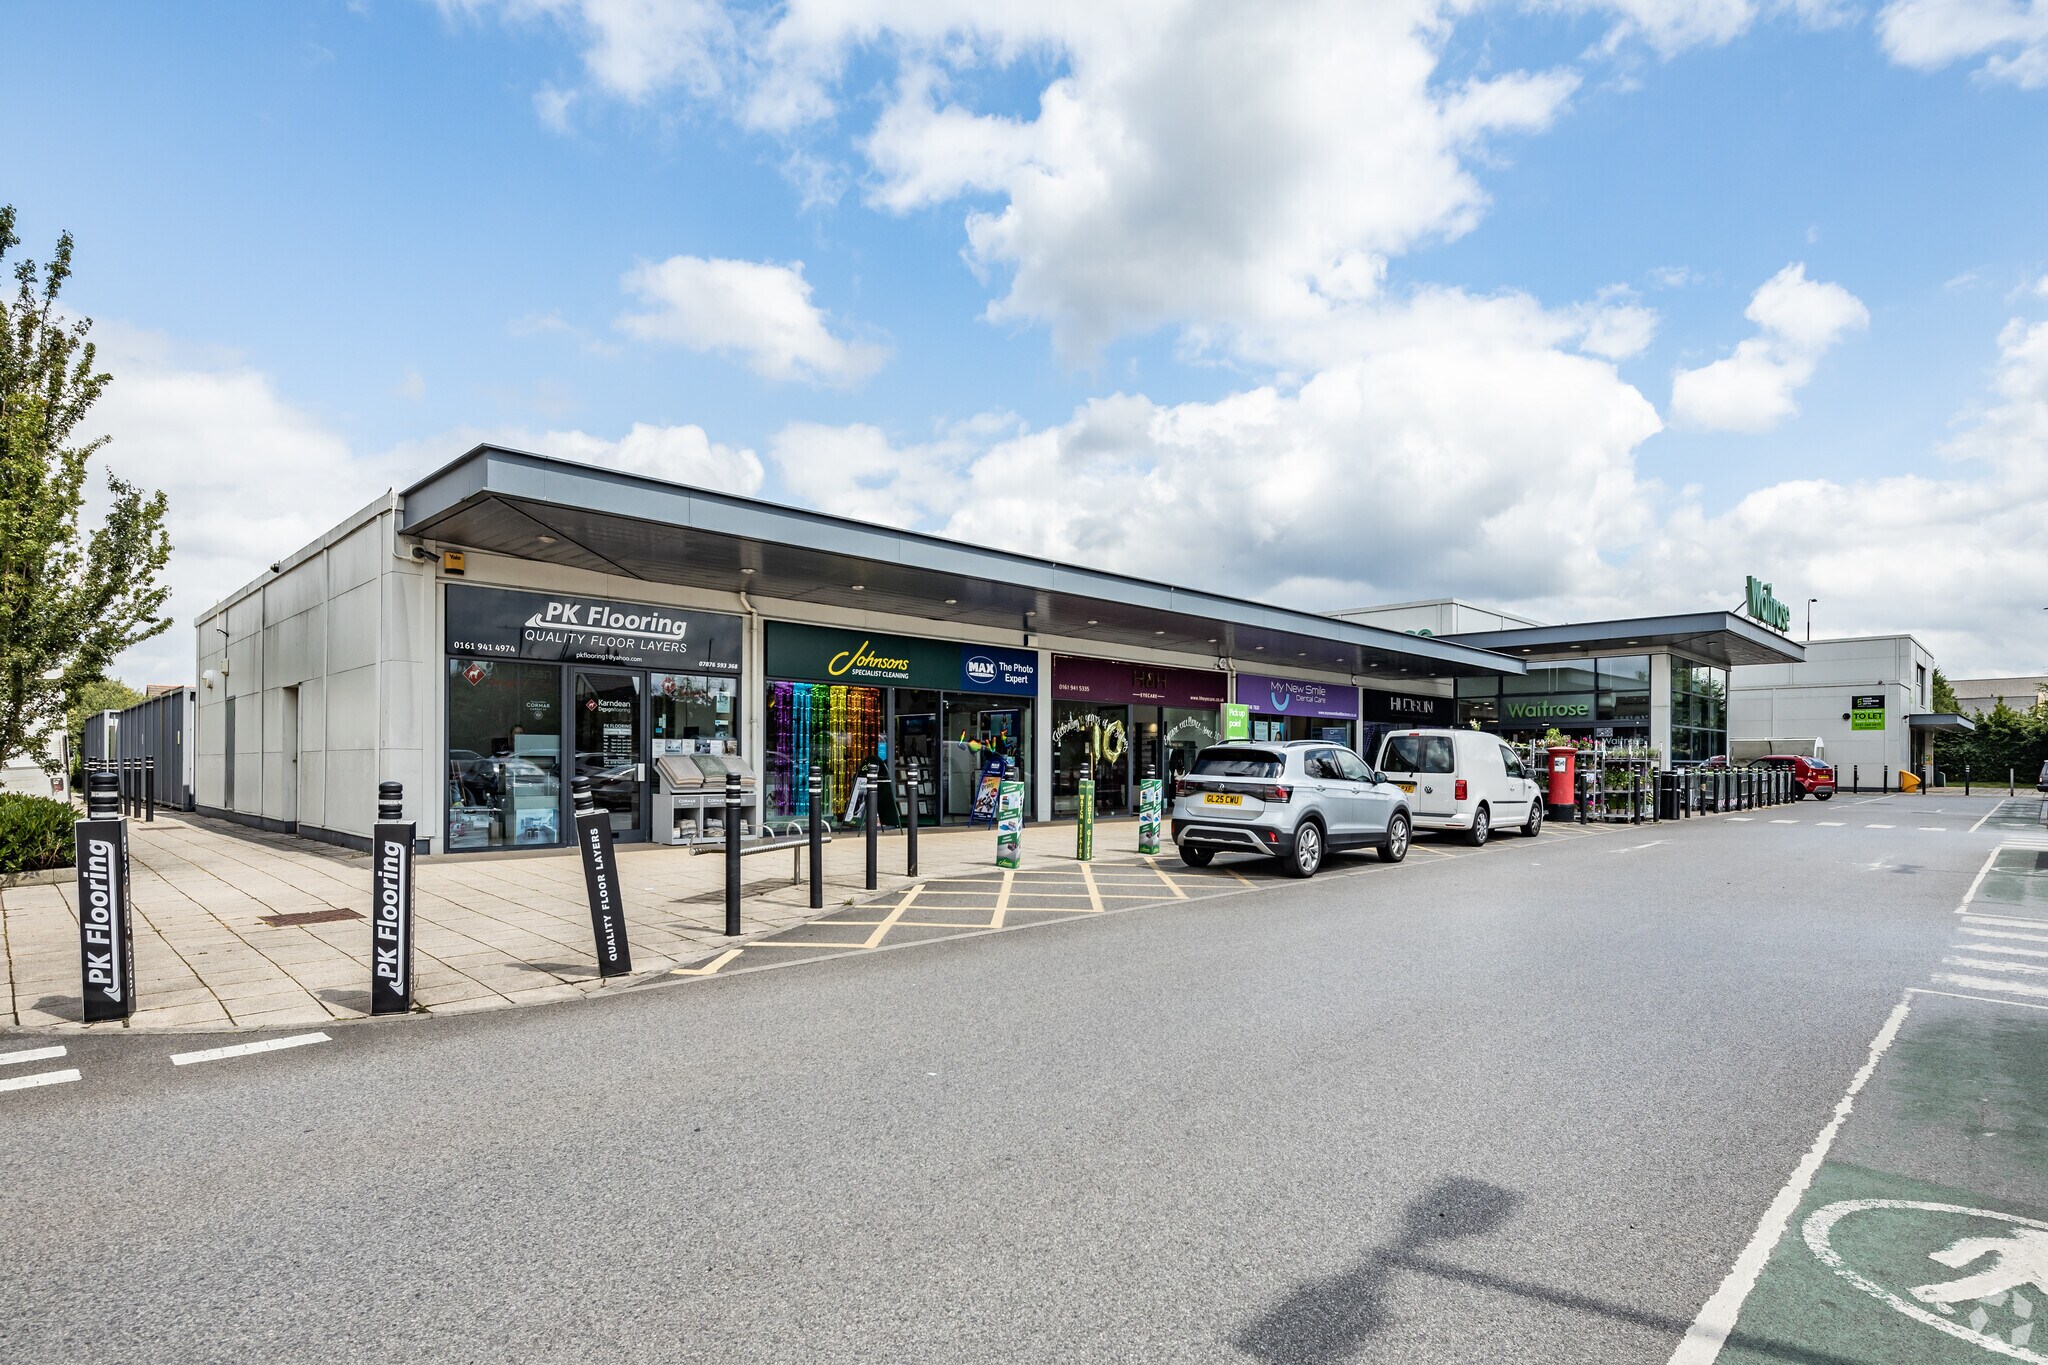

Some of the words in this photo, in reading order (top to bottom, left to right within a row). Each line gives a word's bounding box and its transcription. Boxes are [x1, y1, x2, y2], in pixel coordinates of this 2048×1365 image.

[1746, 575, 1790, 632] Waitrose
[545, 601, 582, 624] PK
[587, 606, 688, 636] Flooring
[454, 641, 475, 651] 0161
[477, 642, 494, 652] 941
[495, 643, 516, 653] 4974
[525, 630, 586, 645] QUALITY
[590, 635, 636, 649] FLOOR
[640, 638, 688, 653] LAYERS
[576, 651, 643, 663] pkflooring1@yahoo.com
[828, 640, 910, 676] Johnsons
[698, 660, 716, 668] 07876
[727, 662, 739, 670] 368
[968, 661, 995, 674] MAX
[999, 662, 1013, 672] The
[1014, 663, 1034, 674] Photo
[851, 668, 882, 677] SPECIALIST
[882, 671, 909, 680] CLEANING
[1005, 673, 1028, 685] Expert
[1270, 681, 1283, 693] My
[1285, 683, 1304, 693] New
[1305, 685, 1326, 696] Smile
[598, 699, 631, 708] Karndean
[1313, 696, 1327, 704] Care
[1228, 708, 1239, 716] Pick
[1239, 710, 1246, 719] up
[1508, 700, 1589, 718] Waitrose
[1228, 719, 1242, 729] point
[1206, 794, 1225, 803] GL25
[1225, 796, 1240, 804] CWU
[590, 828, 604, 871] LAYERS
[83, 839, 114, 945] Flooring
[377, 840, 403, 941] Flooring
[597, 874, 610, 911] FLOOR
[603, 915, 618, 962] QUALITY
[88, 951, 112, 984] PK
[377, 948, 397, 979] PK
